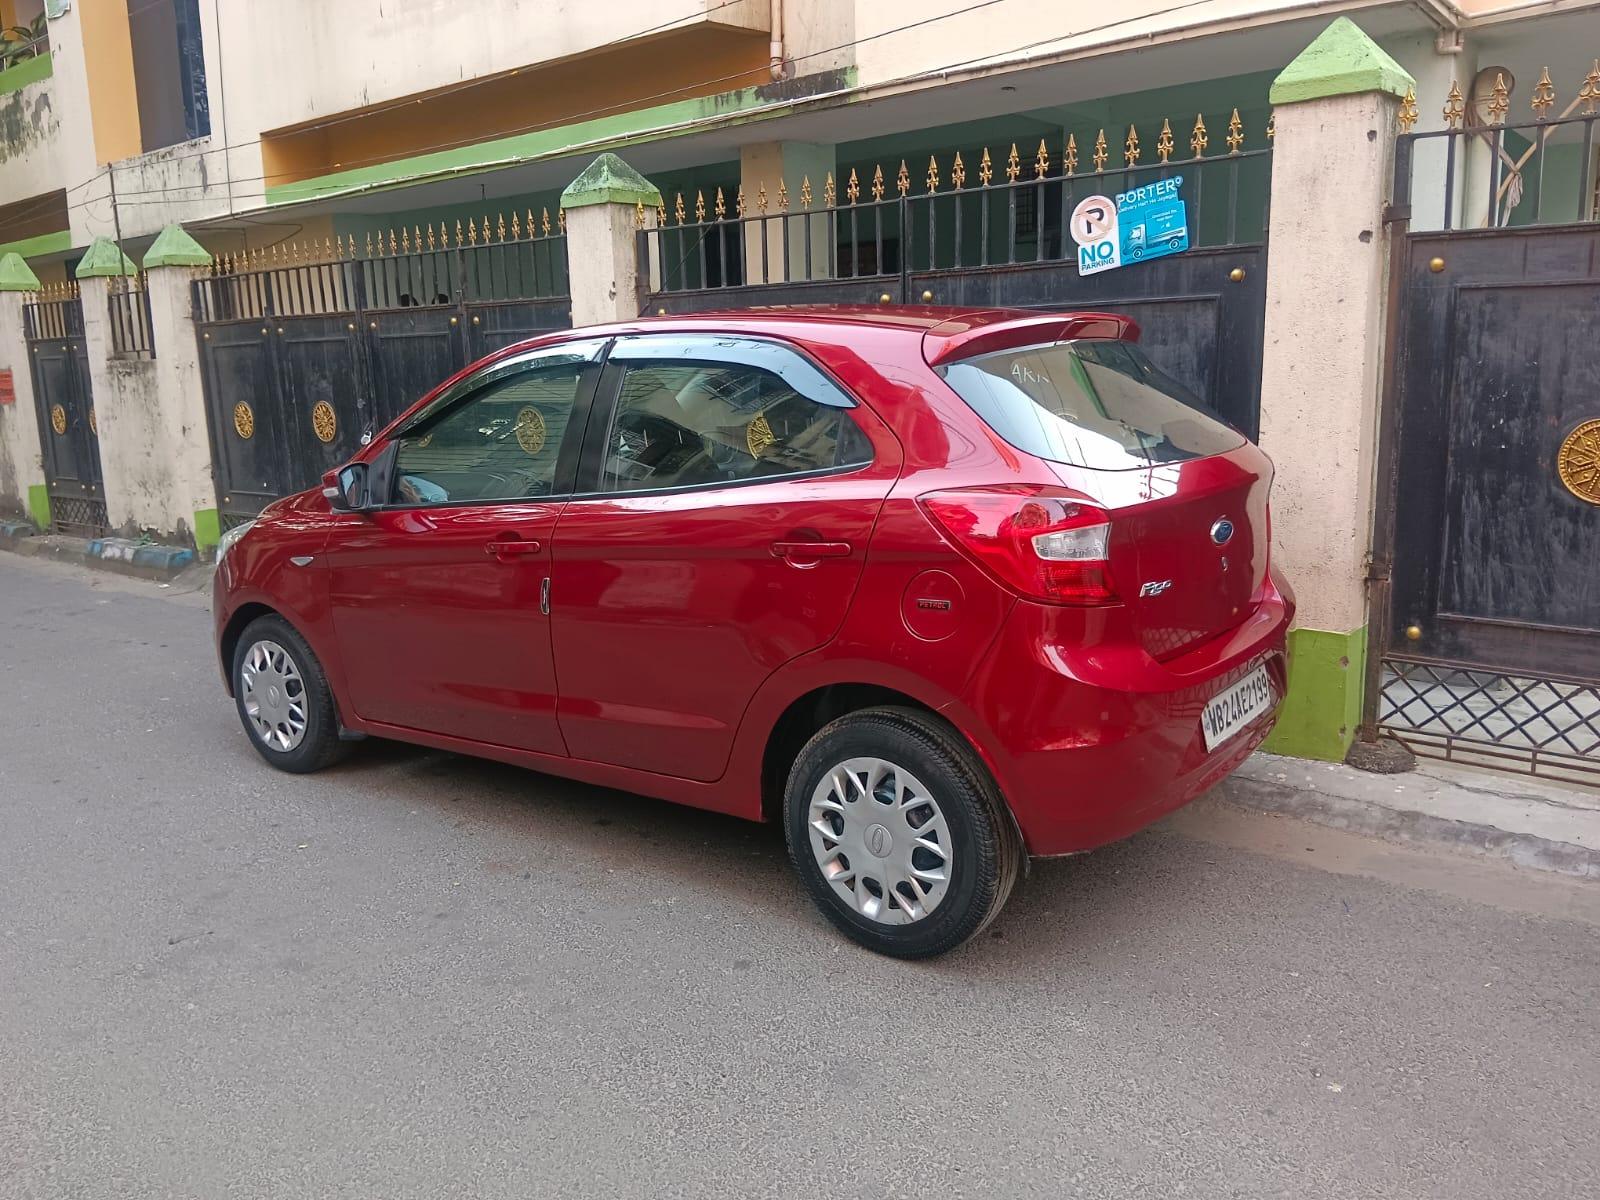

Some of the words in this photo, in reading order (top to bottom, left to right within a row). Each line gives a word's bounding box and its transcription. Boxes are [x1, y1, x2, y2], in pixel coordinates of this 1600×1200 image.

[1116, 179, 1178, 207] PORTER
[1080, 241, 1114, 265] NO
[1081, 257, 1115, 272] PARKING
[1208, 673, 1268, 737] WB24AE2199
